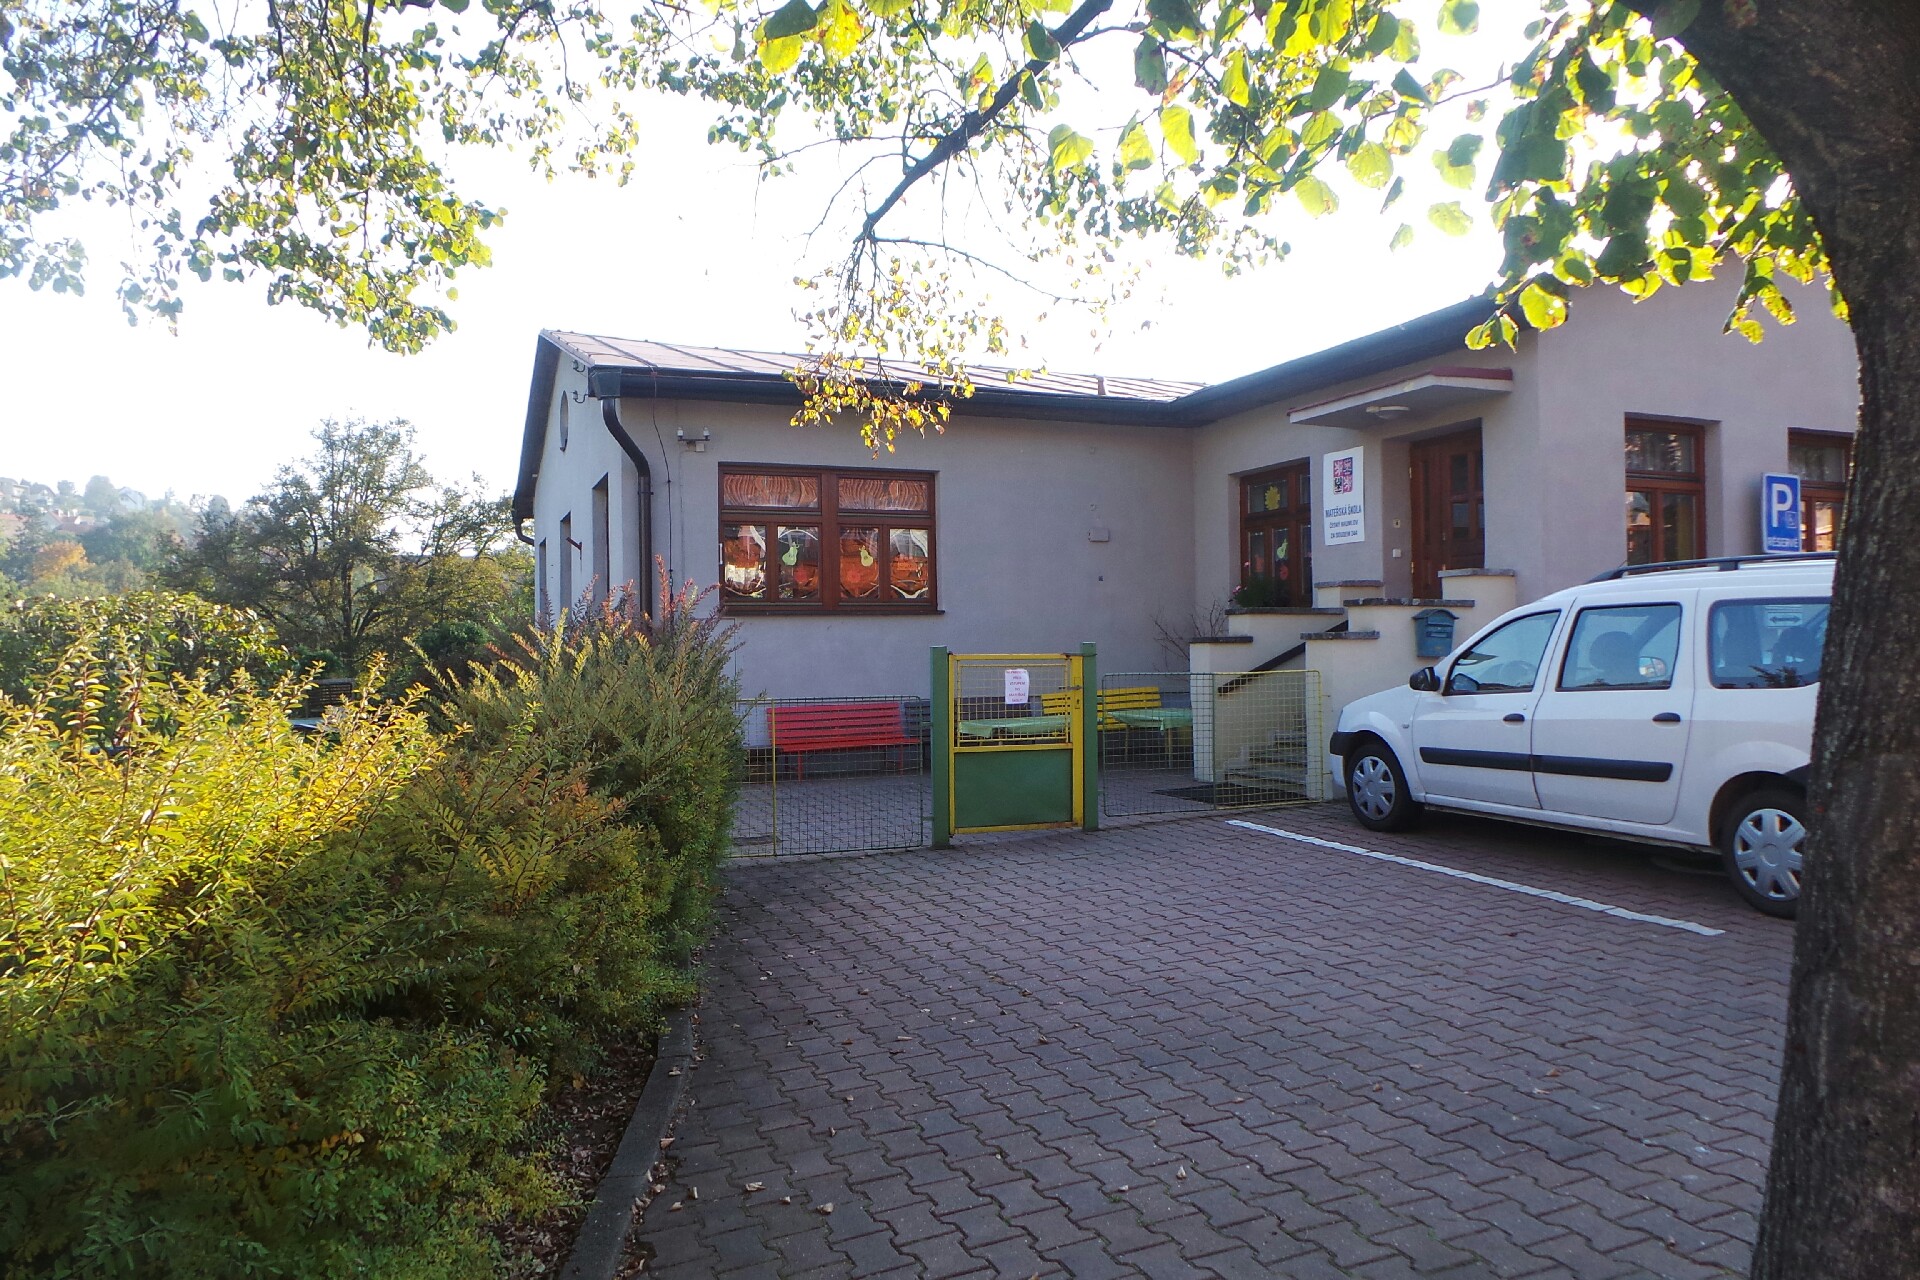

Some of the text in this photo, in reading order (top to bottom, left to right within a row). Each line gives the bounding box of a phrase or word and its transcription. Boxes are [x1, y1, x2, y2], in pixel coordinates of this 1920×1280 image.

[1325, 504, 1362, 517] MATEŘSKÁ ŠKOLA
[1772, 483, 1792, 527] P
